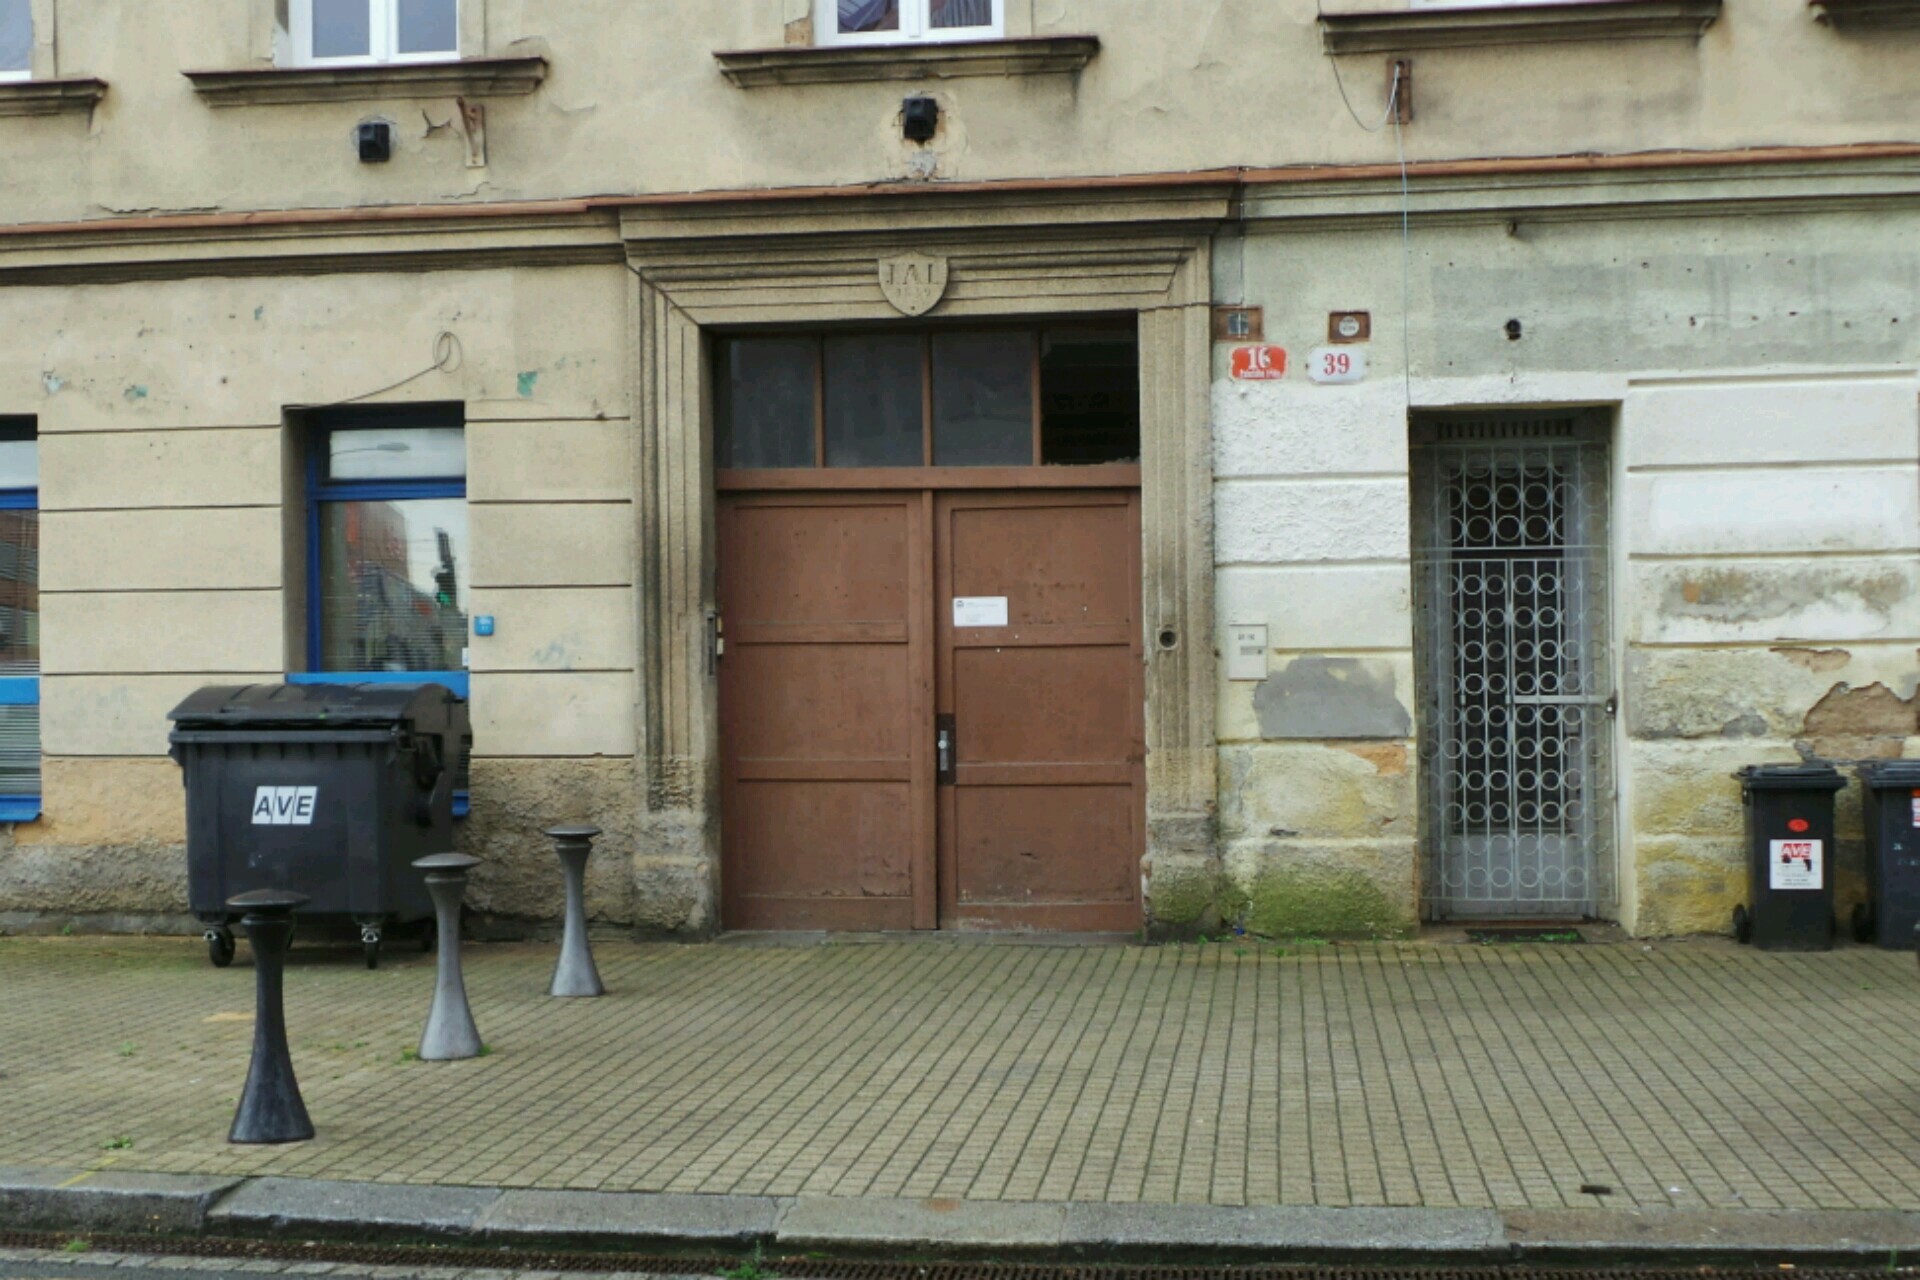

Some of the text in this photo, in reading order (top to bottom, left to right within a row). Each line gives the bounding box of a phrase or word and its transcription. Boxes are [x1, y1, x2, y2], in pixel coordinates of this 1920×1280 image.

[1247, 346, 1272, 371] 16
[1322, 352, 1351, 376] 39
[253, 793, 314, 818] AVE
[1782, 843, 1812, 858] AVE
